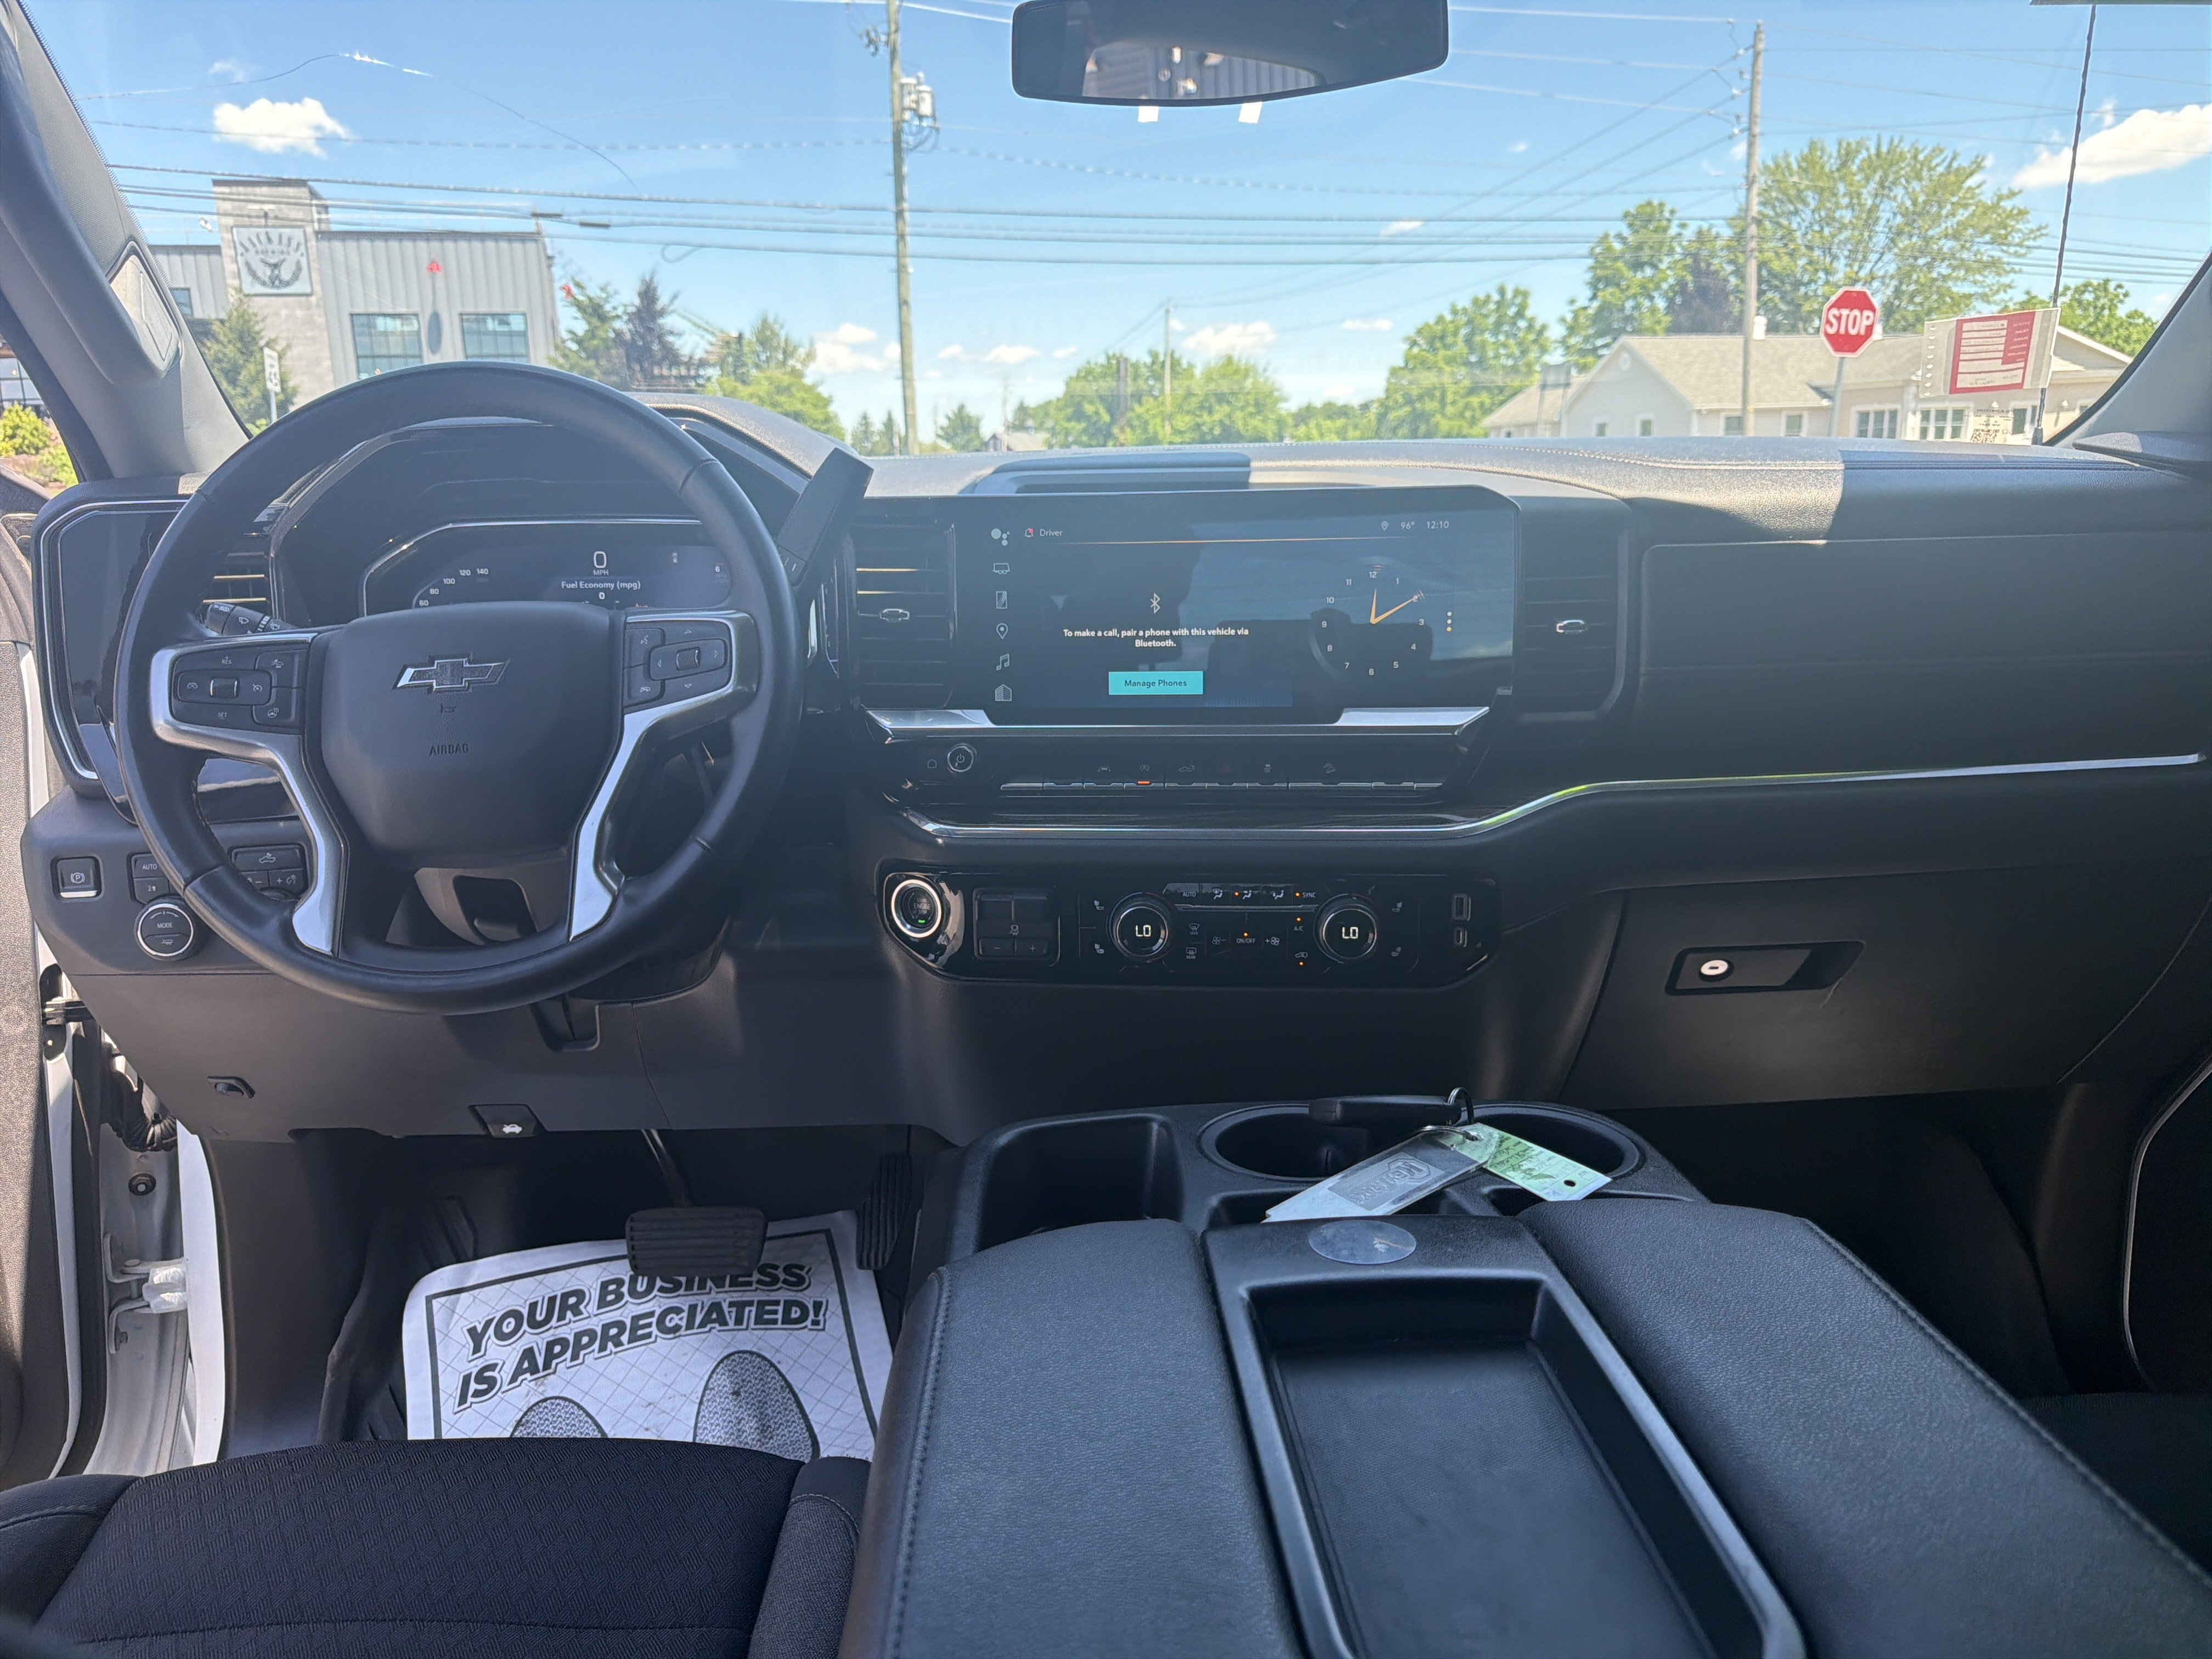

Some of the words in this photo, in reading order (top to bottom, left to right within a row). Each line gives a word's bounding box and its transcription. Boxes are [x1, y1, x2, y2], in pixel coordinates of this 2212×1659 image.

[1825, 307, 1874, 336] STOP
[1426, 521, 1449, 529] 12:10
[593, 551, 607, 568] 0
[579, 581, 615, 590] Economy
[617, 580, 641, 590] (mpg)
[599, 591, 606, 600] 0
[1063, 629, 1073, 637] To
[1074, 628, 1096, 637] make
[1104, 628, 1119, 637] call,
[1121, 628, 1137, 639] pair
[1146, 628, 1171, 638] phone
[1172, 628, 1189, 636] with
[1191, 628, 1206, 636] this
[1207, 627, 1235, 636] vehicle
[1237, 627, 1249, 636] via
[1135, 639, 1177, 647] Bluetooth.
[1125, 680, 1156, 689] Manage
[430, 743, 470, 756] AIRBAG
[1135, 924, 1152, 937] LO
[1342, 927, 1359, 939] LO
[466, 1288, 587, 1356] YOUR
[457, 1362, 499, 1408] IS
[507, 1299, 825, 1386] APPRECIATED!
